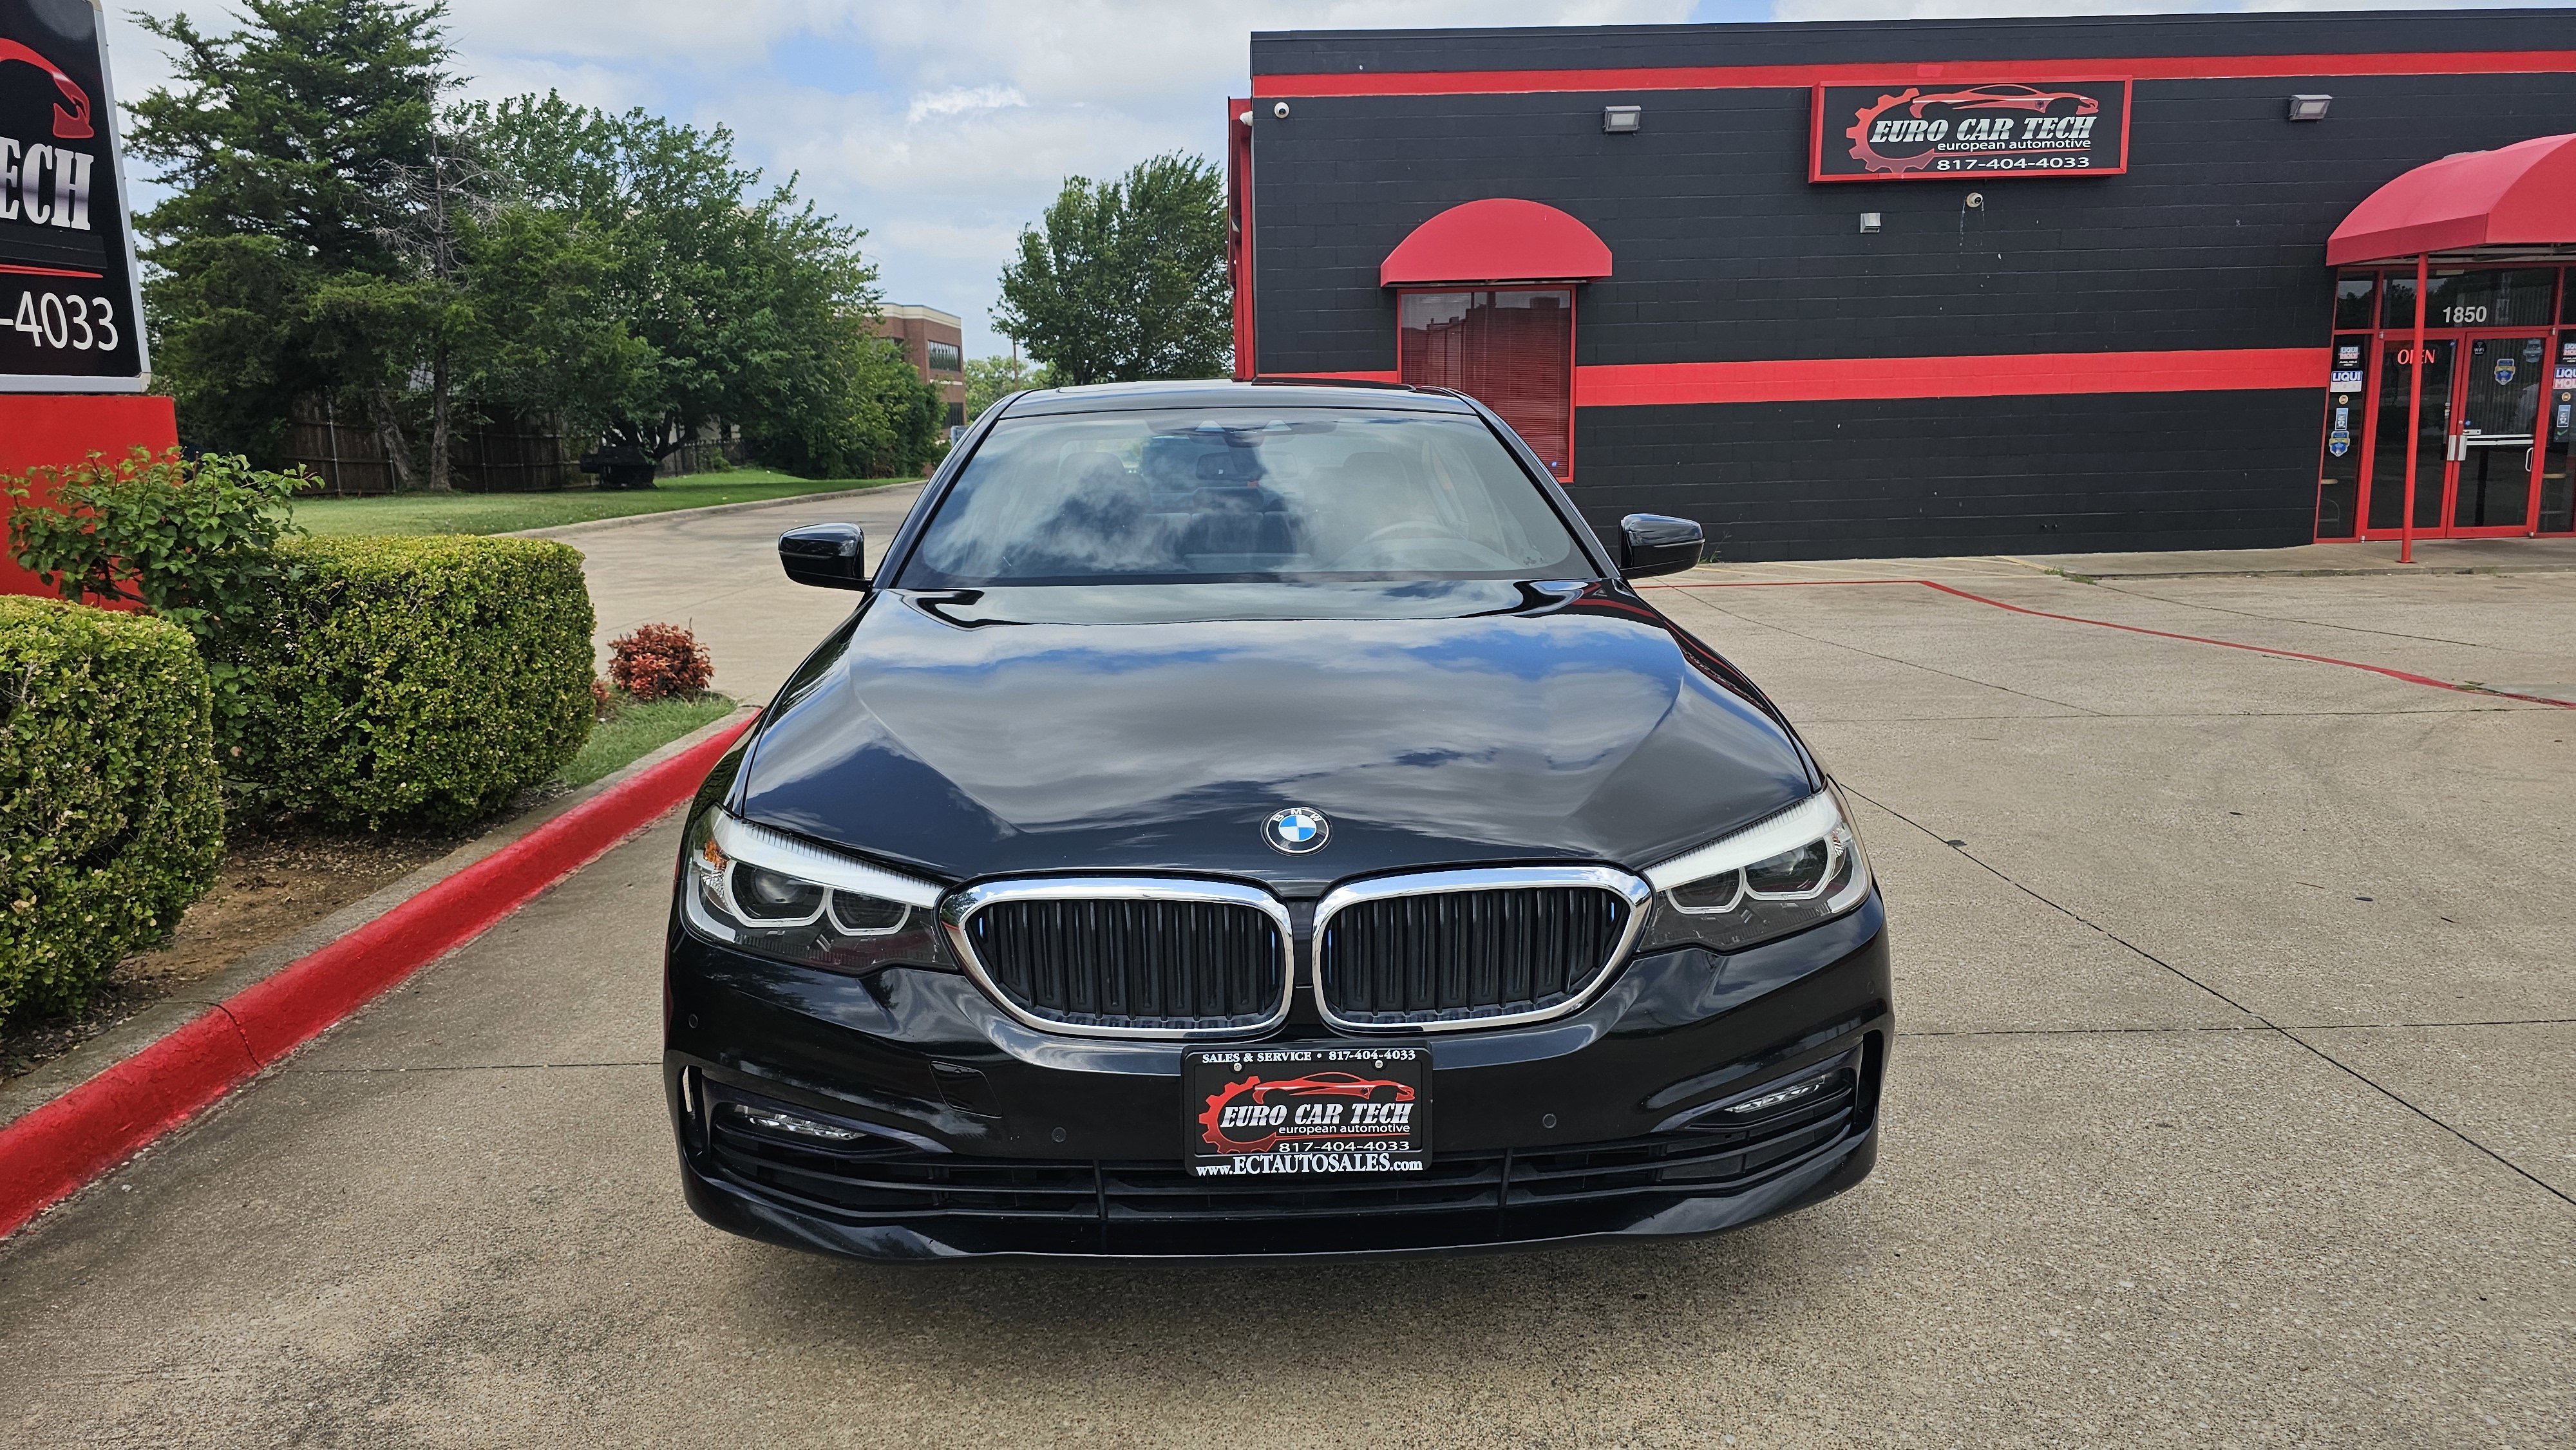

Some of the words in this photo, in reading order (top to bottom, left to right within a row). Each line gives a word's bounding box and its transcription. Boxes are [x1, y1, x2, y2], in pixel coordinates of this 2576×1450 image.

[1870, 119, 1949, 143] EURO
[1956, 118, 2014, 141] CAR
[2022, 117, 2097, 140] TECH
[1937, 141, 2005, 152] european
[2009, 138, 2091, 149] automotive
[1937, 157, 2090, 171] 817-404-4033
[0, 291, 118, 351] -4033
[2443, 306, 2487, 323] 1850
[2333, 372, 2362, 382] LIQUI
[1272, 809, 1322, 822] BMW
[1202, 1053, 1240, 1063] SALES
[1243, 1053, 1254, 1062] &
[1257, 1051, 1312, 1062] SERVICE
[1329, 1050, 1416, 1060] 817-404-4033
[1220, 1104, 1287, 1127] EURO
[1294, 1104, 1343, 1125] CAR
[1350, 1103, 1414, 1124] TECH
[1278, 1125, 1337, 1135] european
[1340, 1124, 1410, 1133] automotive
[1279, 1141, 1410, 1153] 817-404-4033
[1196, 1153, 1423, 1176] www.ECTAUTOSALES.com
